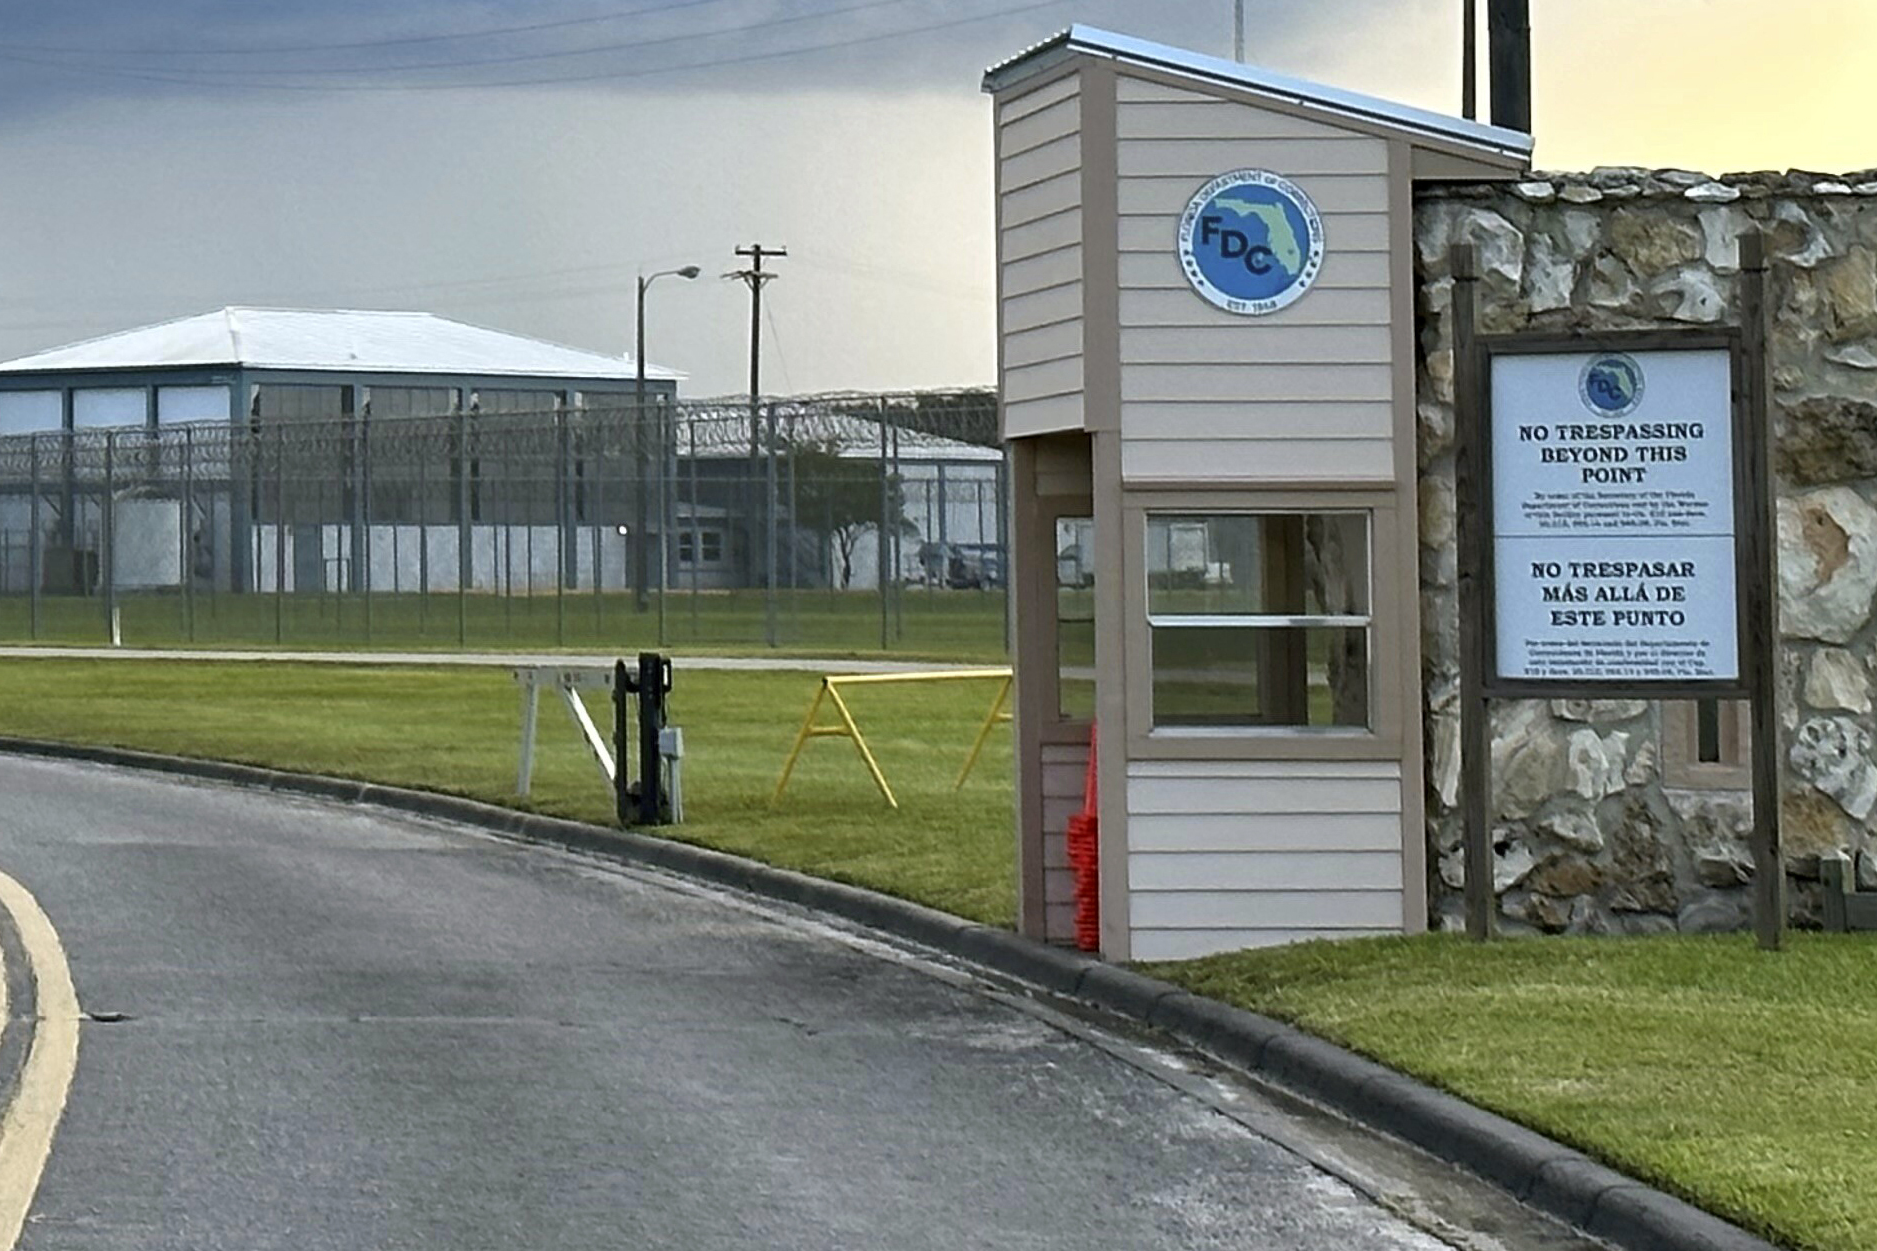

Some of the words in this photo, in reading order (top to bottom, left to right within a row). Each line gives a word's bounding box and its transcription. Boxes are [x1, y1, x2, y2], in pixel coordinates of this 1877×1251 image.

[1201, 216, 1273, 276] FDC
[1519, 425, 1549, 441] NO
[1555, 423, 1704, 440] TRESPASSING
[1541, 446, 1628, 463] BEYOND
[1636, 445, 1687, 462] THIS
[1582, 467, 1646, 483] POINT
[1531, 562, 1562, 578] NO
[1568, 561, 1695, 578] TRESPASAR
[1542, 583, 1588, 602] MÁS
[1594, 582, 1649, 602] ALLÁ
[1656, 586, 1686, 602] DE
[1550, 610, 1606, 626] ESTE
[1613, 610, 1685, 626] PUNTO
